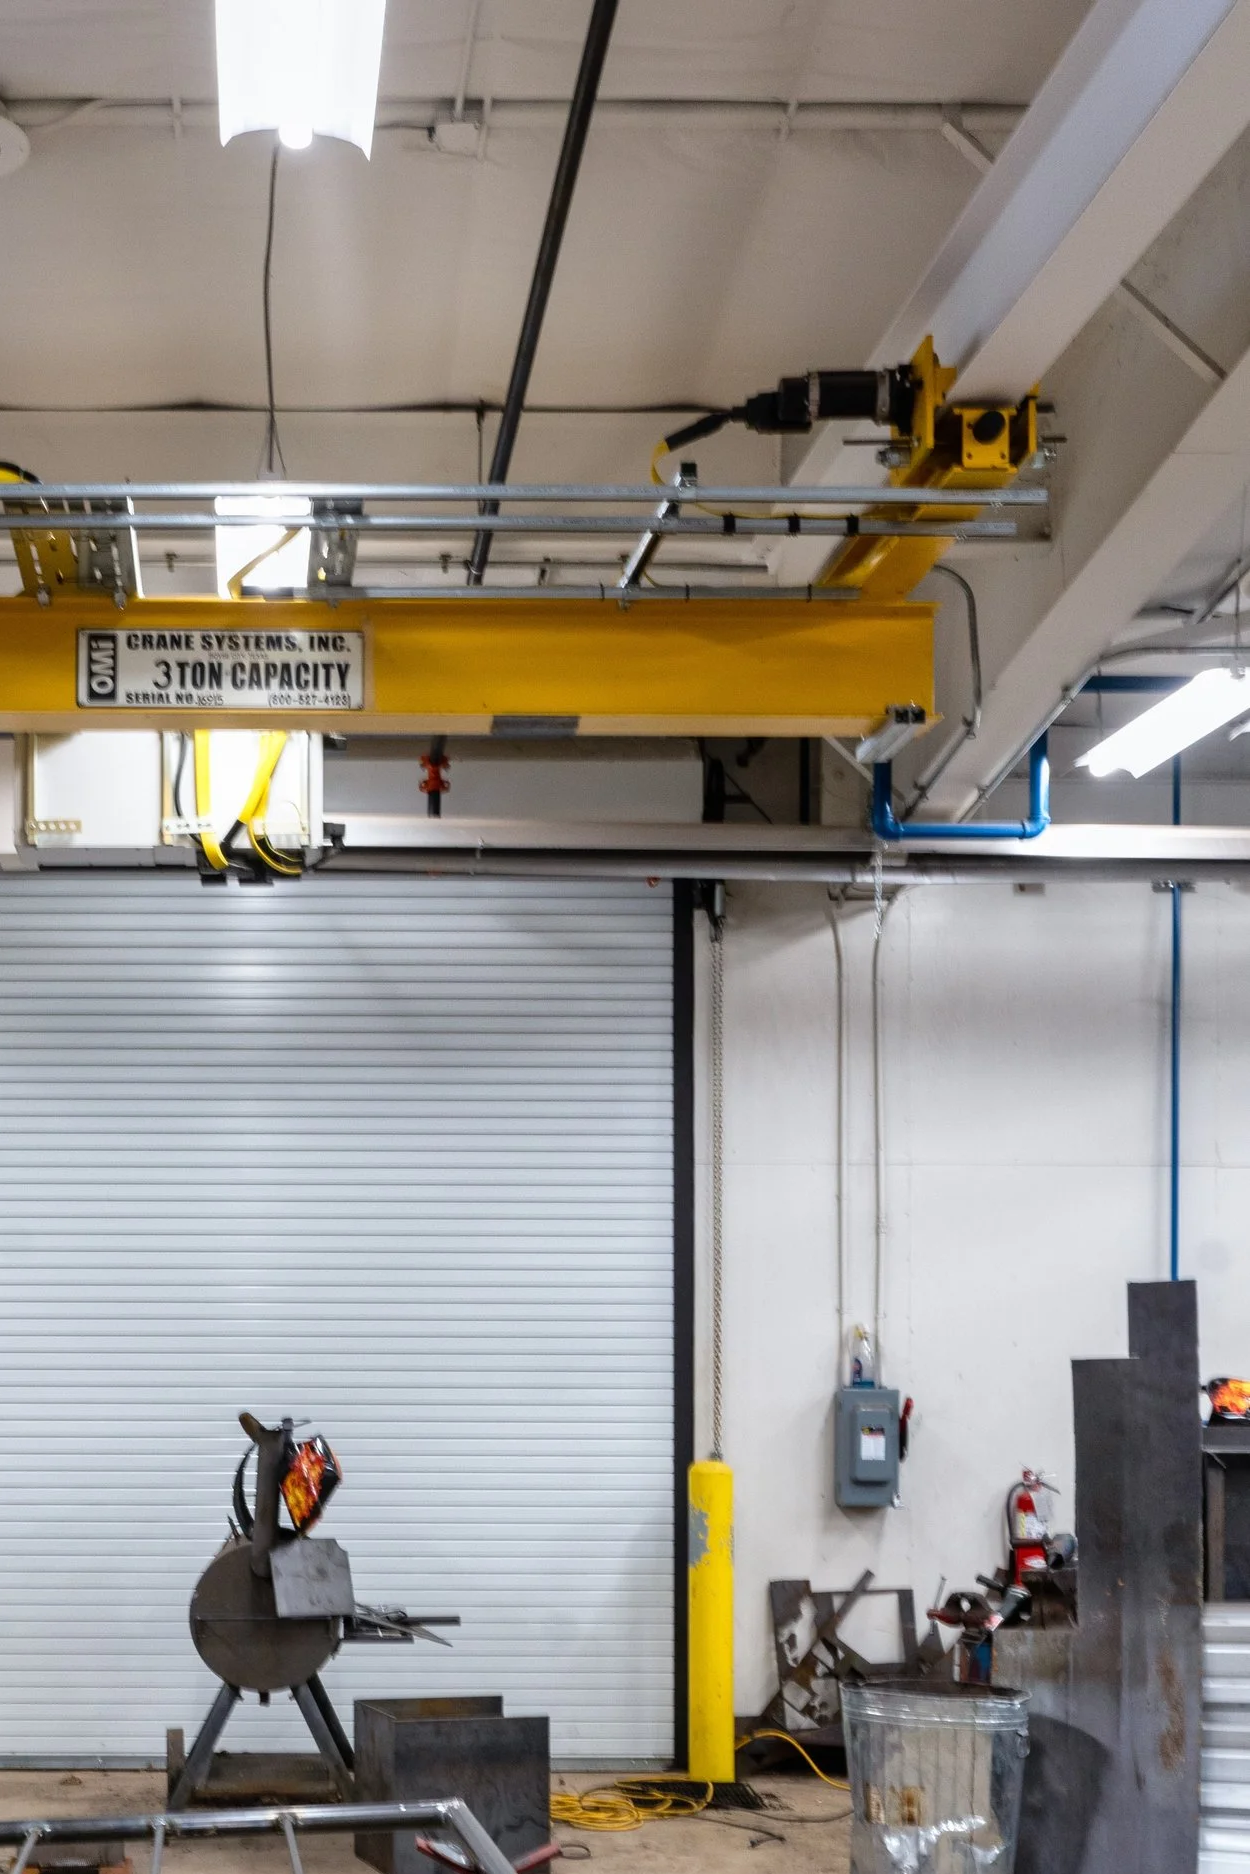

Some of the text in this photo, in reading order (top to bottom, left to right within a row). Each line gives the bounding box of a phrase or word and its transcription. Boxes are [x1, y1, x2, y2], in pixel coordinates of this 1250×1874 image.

[126, 634, 195, 650] CRANE
[309, 635, 351, 652] INC.
[153, 660, 351, 691] 3 TON CAPACITY
[125, 692, 171, 704] SERIAL
